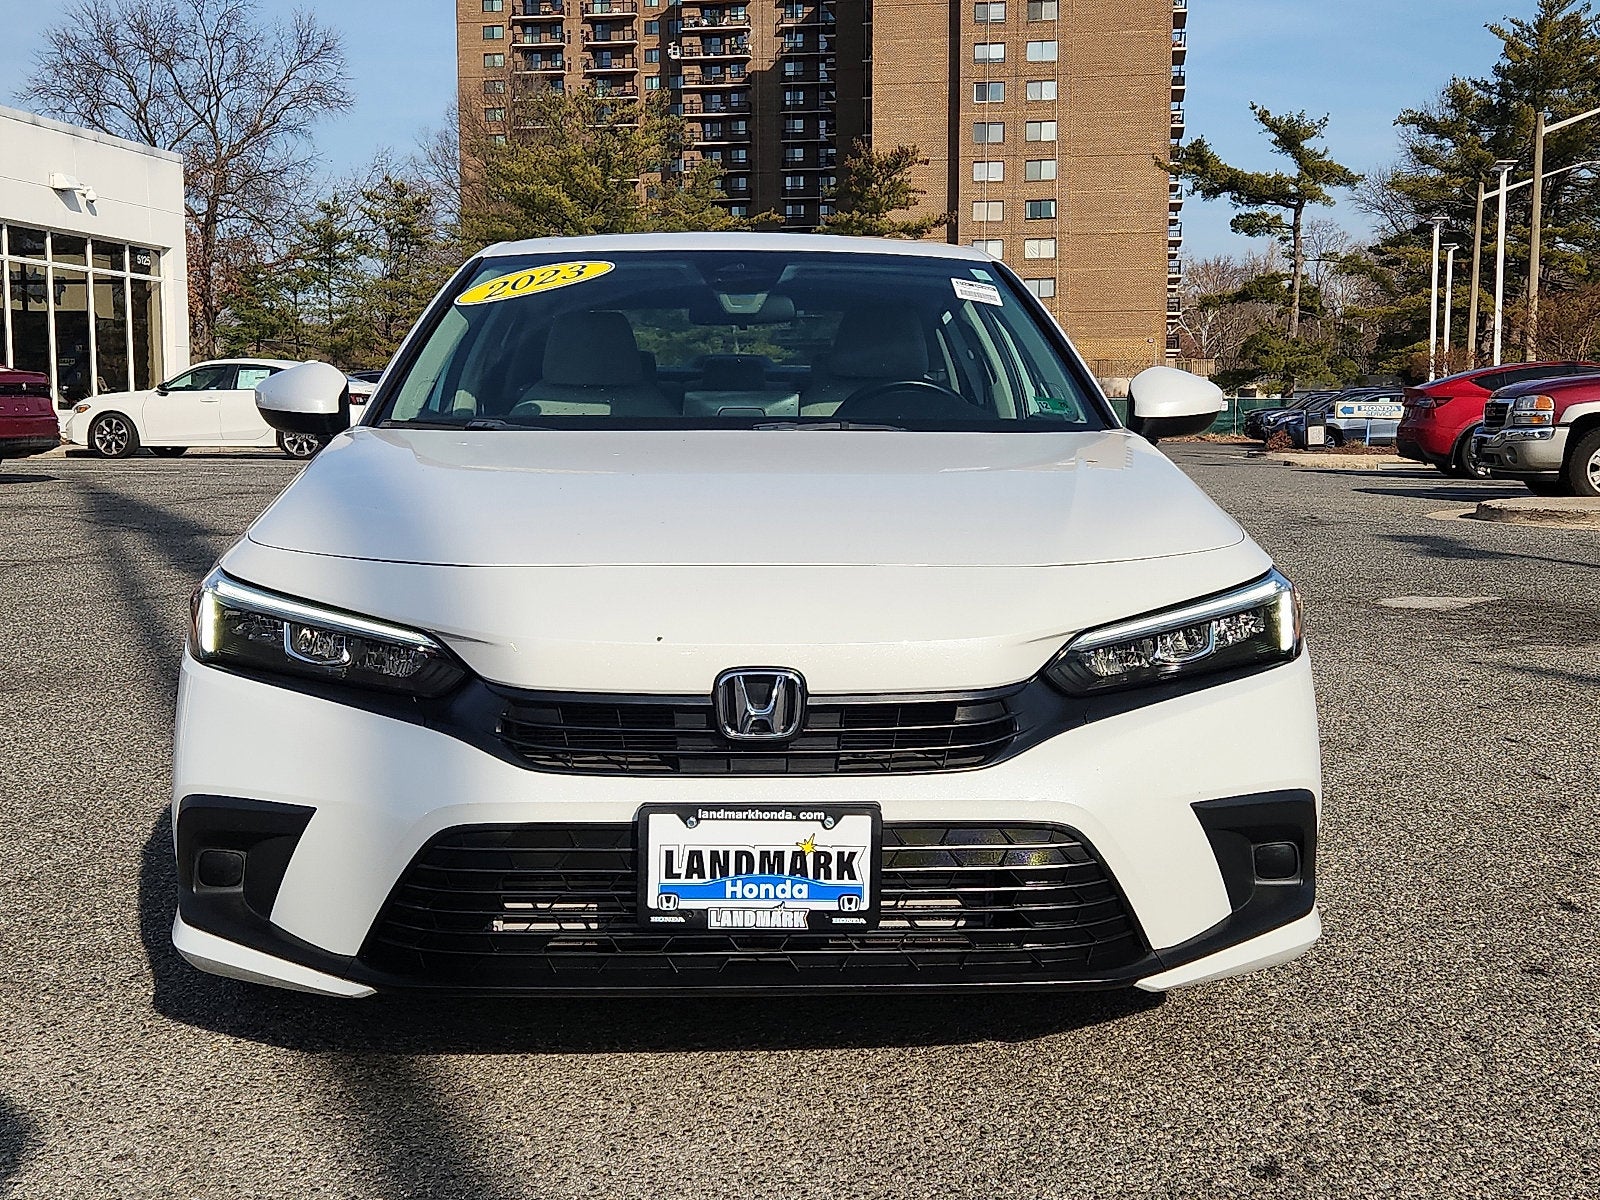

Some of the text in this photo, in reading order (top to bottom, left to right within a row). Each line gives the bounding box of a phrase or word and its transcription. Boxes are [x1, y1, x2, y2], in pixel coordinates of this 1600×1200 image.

[136, 254, 151, 266] 5125
[484, 264, 588, 300] 2023
[664, 849, 858, 881] LANDMARK
[725, 879, 809, 899] Honda
[650, 915, 686, 923] HONDA
[709, 908, 808, 929] LANDMARK
[831, 917, 867, 925] HONDA
